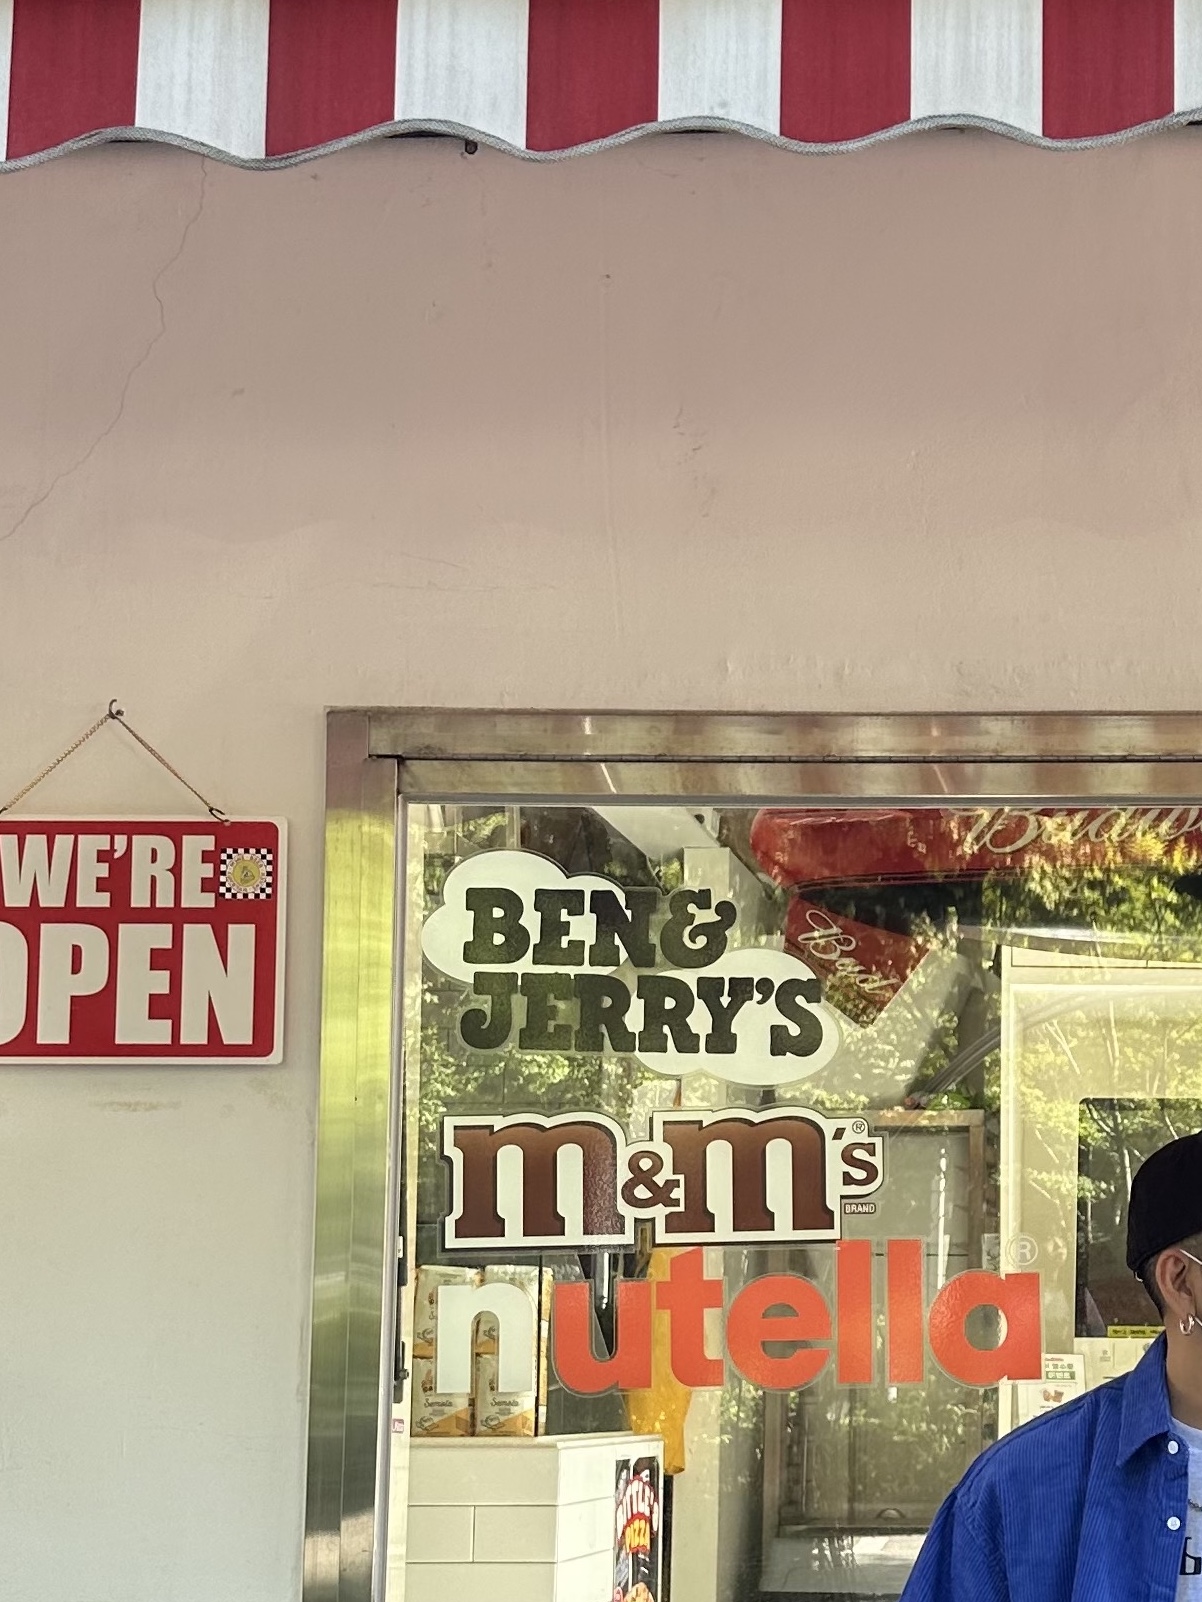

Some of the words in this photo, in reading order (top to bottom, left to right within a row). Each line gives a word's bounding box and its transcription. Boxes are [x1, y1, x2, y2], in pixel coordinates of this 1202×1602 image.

[0, 833, 216, 908] WE'RE
[460, 971, 824, 1057] JERRY'S
[844, 1203, 876, 1213] BRAND
[436, 1239, 1042, 1395] nutella
[625, 1518, 650, 1553] PIZZA
